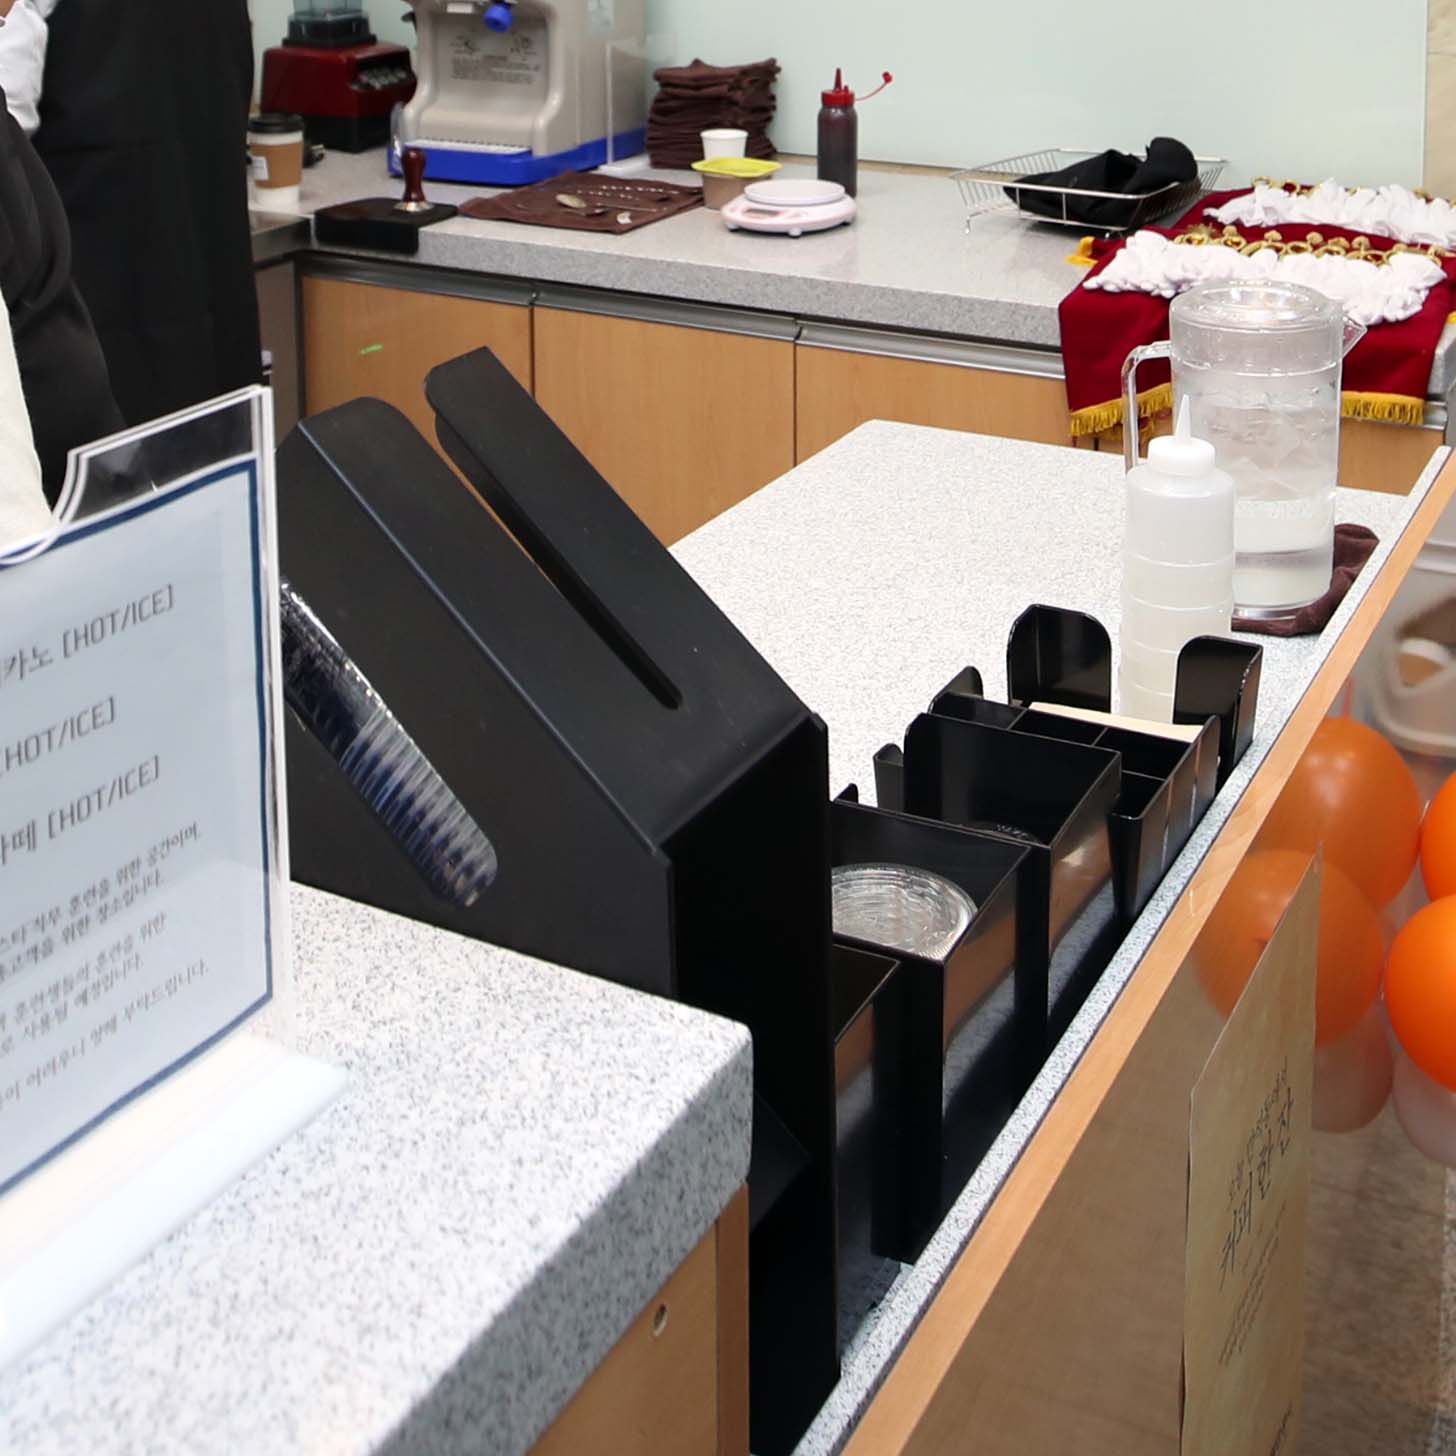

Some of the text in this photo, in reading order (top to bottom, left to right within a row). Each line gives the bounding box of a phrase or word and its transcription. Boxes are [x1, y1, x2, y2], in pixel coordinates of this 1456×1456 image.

[62, 583, 174, 659] [HOT/ICE]
[47, 754, 160, 840] [HOT/ICE]
[116, 856, 142, 886] 위한
[62, 914, 91, 945] 위한
[140, 911, 167, 941] 위한
